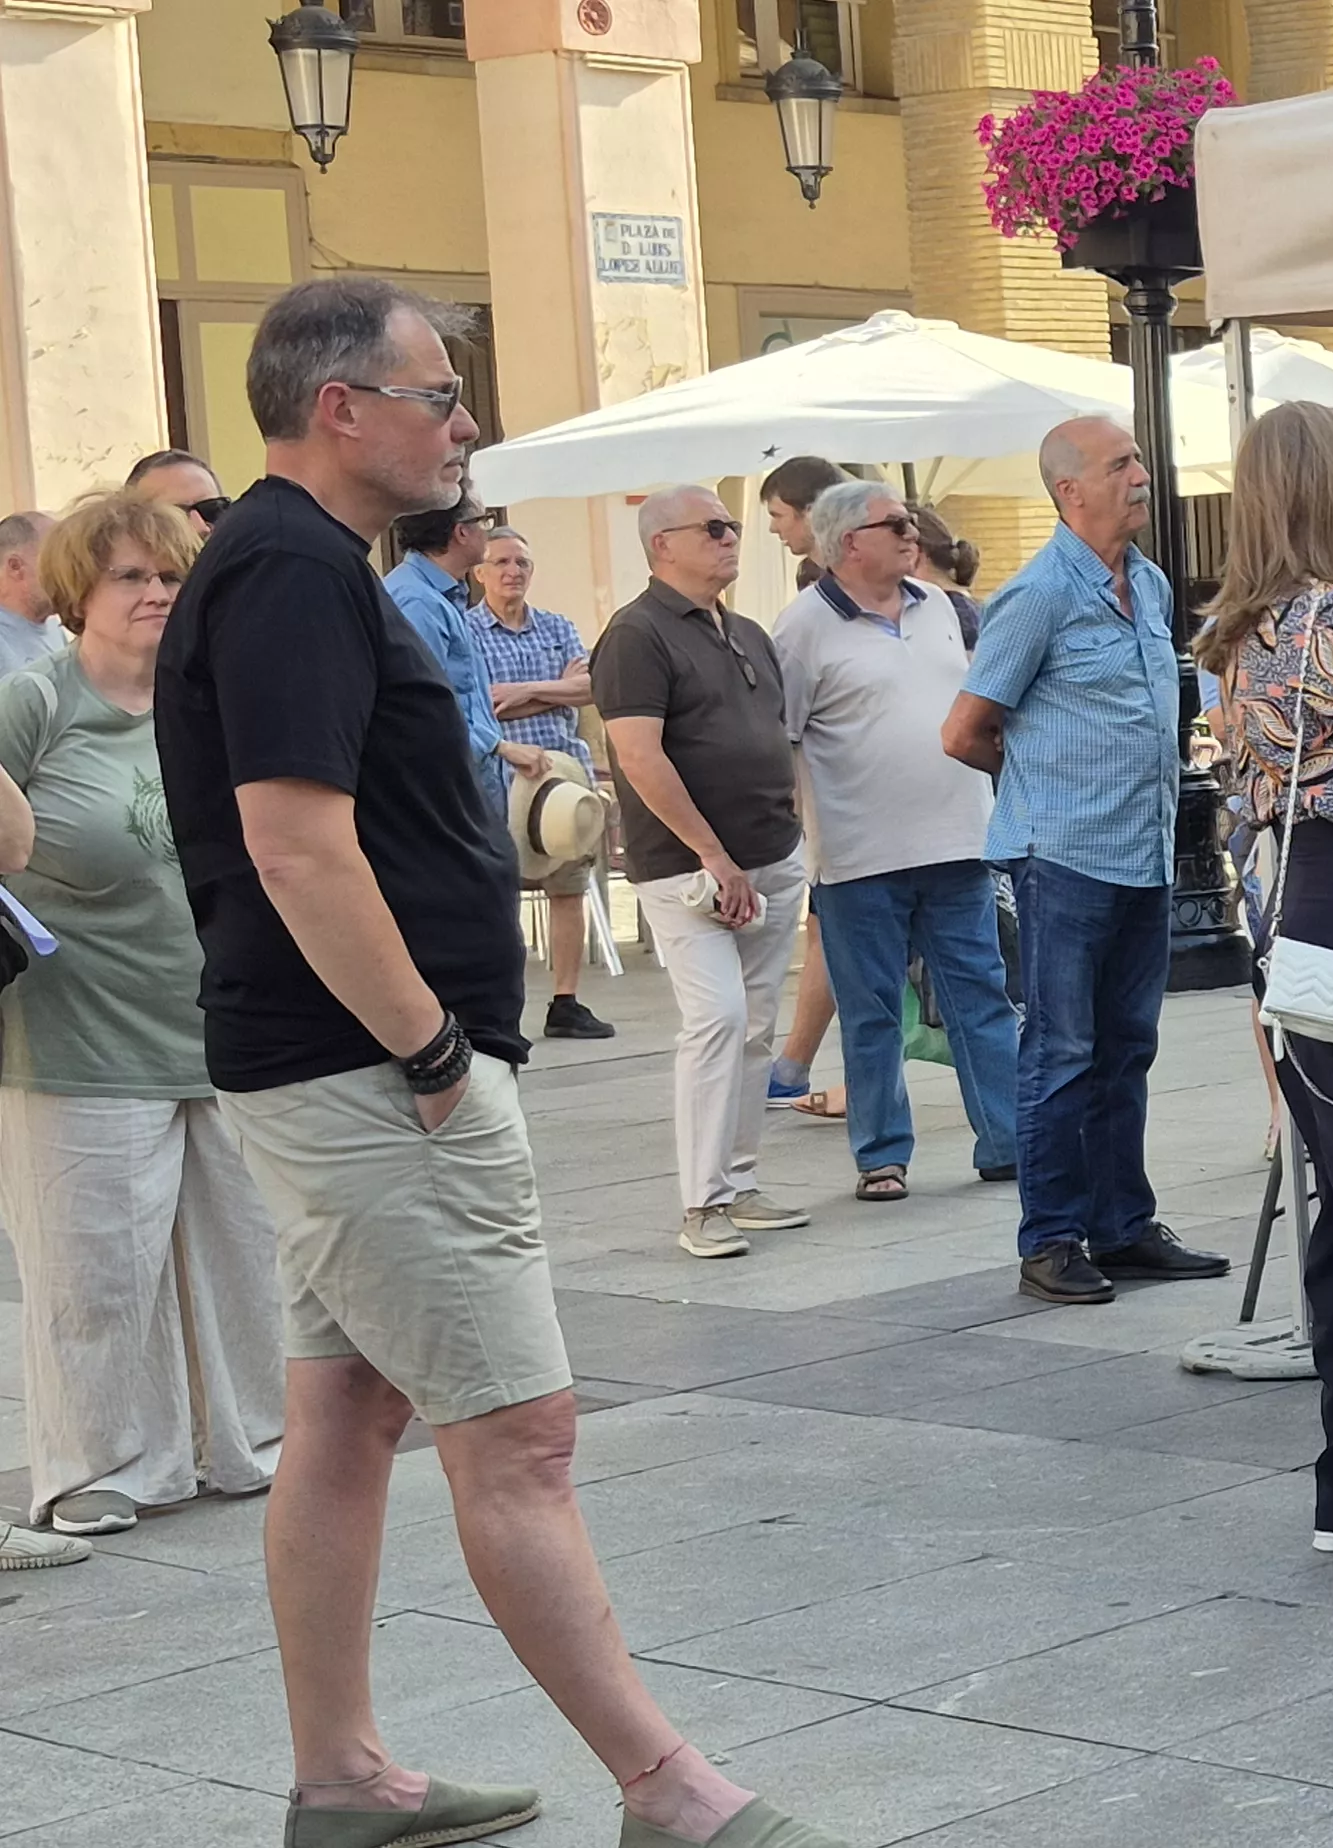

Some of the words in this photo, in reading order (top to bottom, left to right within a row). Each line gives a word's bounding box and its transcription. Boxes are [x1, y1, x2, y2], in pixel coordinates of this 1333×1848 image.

[621, 224, 659, 238] PLAZA
[663, 228, 676, 238] DE
[640, 242, 671, 256] LUIS
